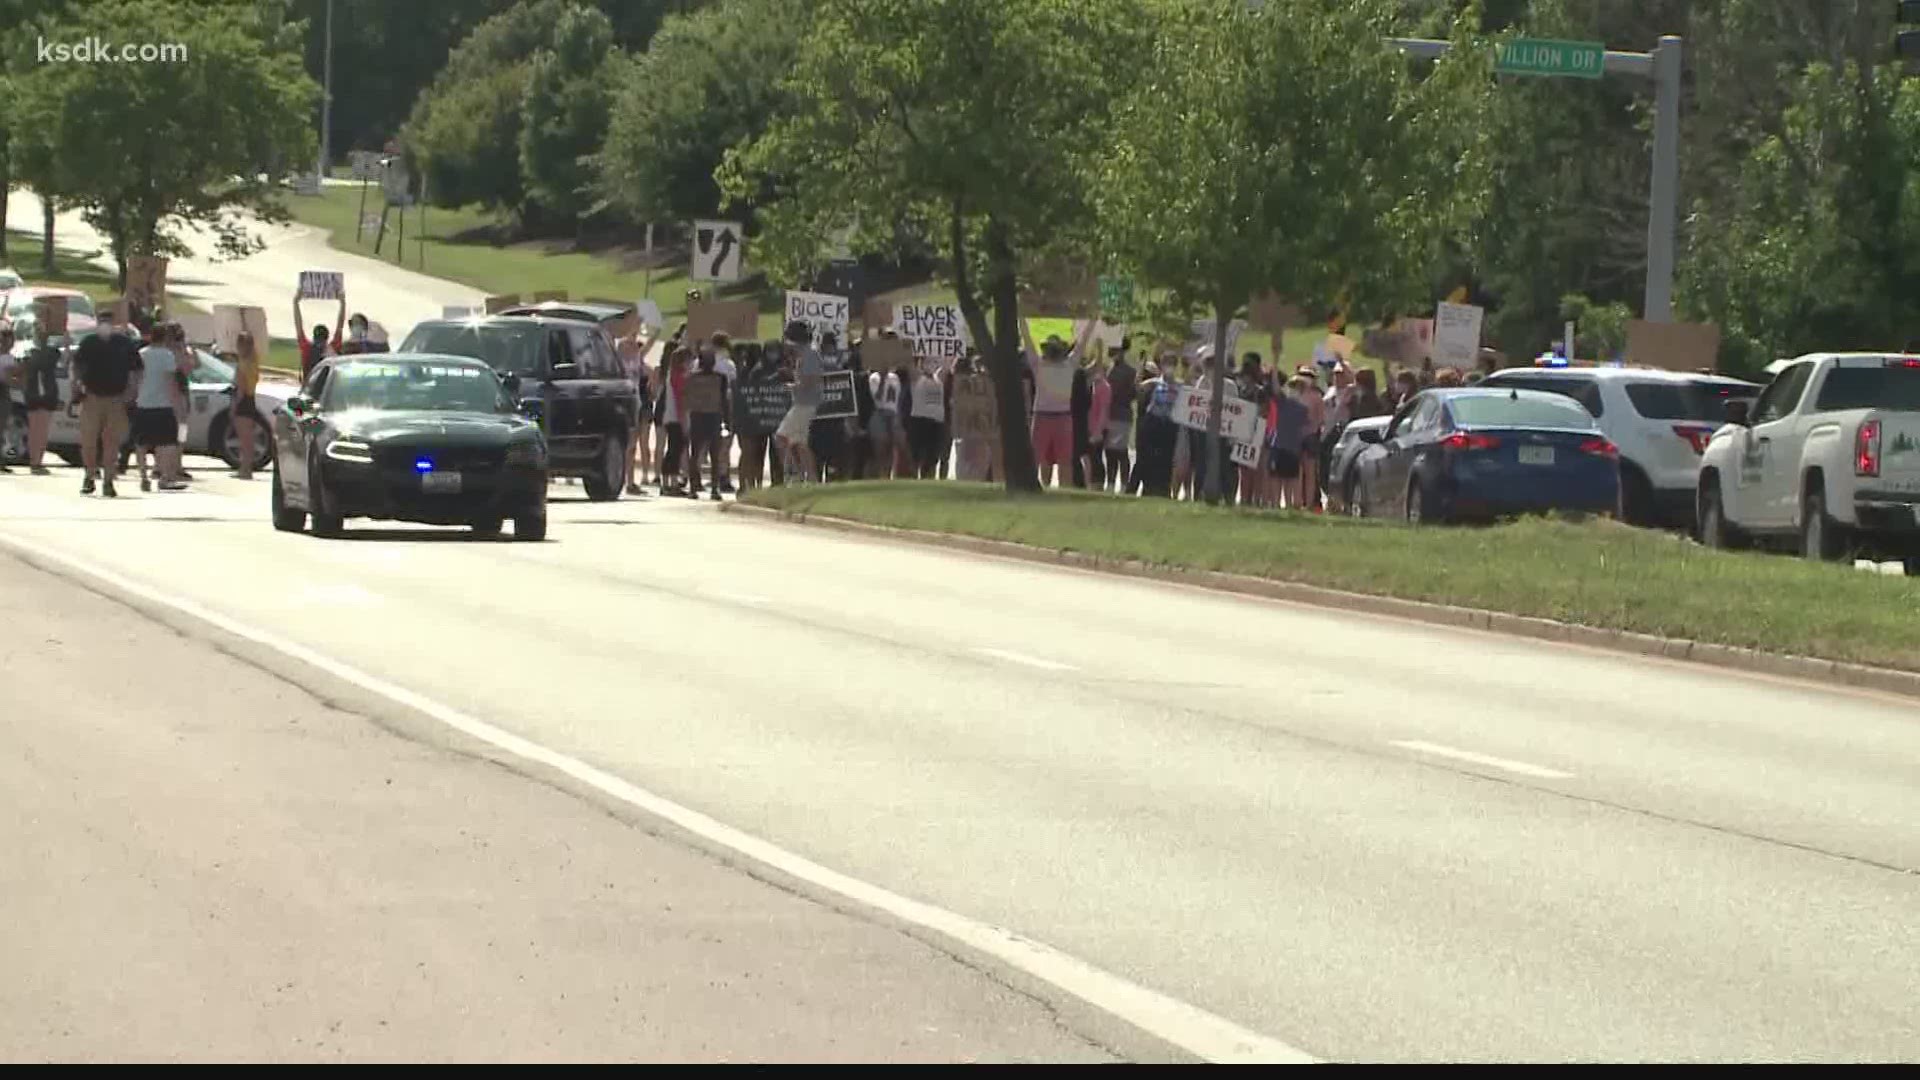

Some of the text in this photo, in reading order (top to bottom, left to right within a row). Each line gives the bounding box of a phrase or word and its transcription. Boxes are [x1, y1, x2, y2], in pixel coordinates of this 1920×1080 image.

[1572, 50, 1596, 69] DR
[903, 306, 956, 321] BLACK
[904, 320, 956, 337] LIVES
[1236, 443, 1257, 461] TER
